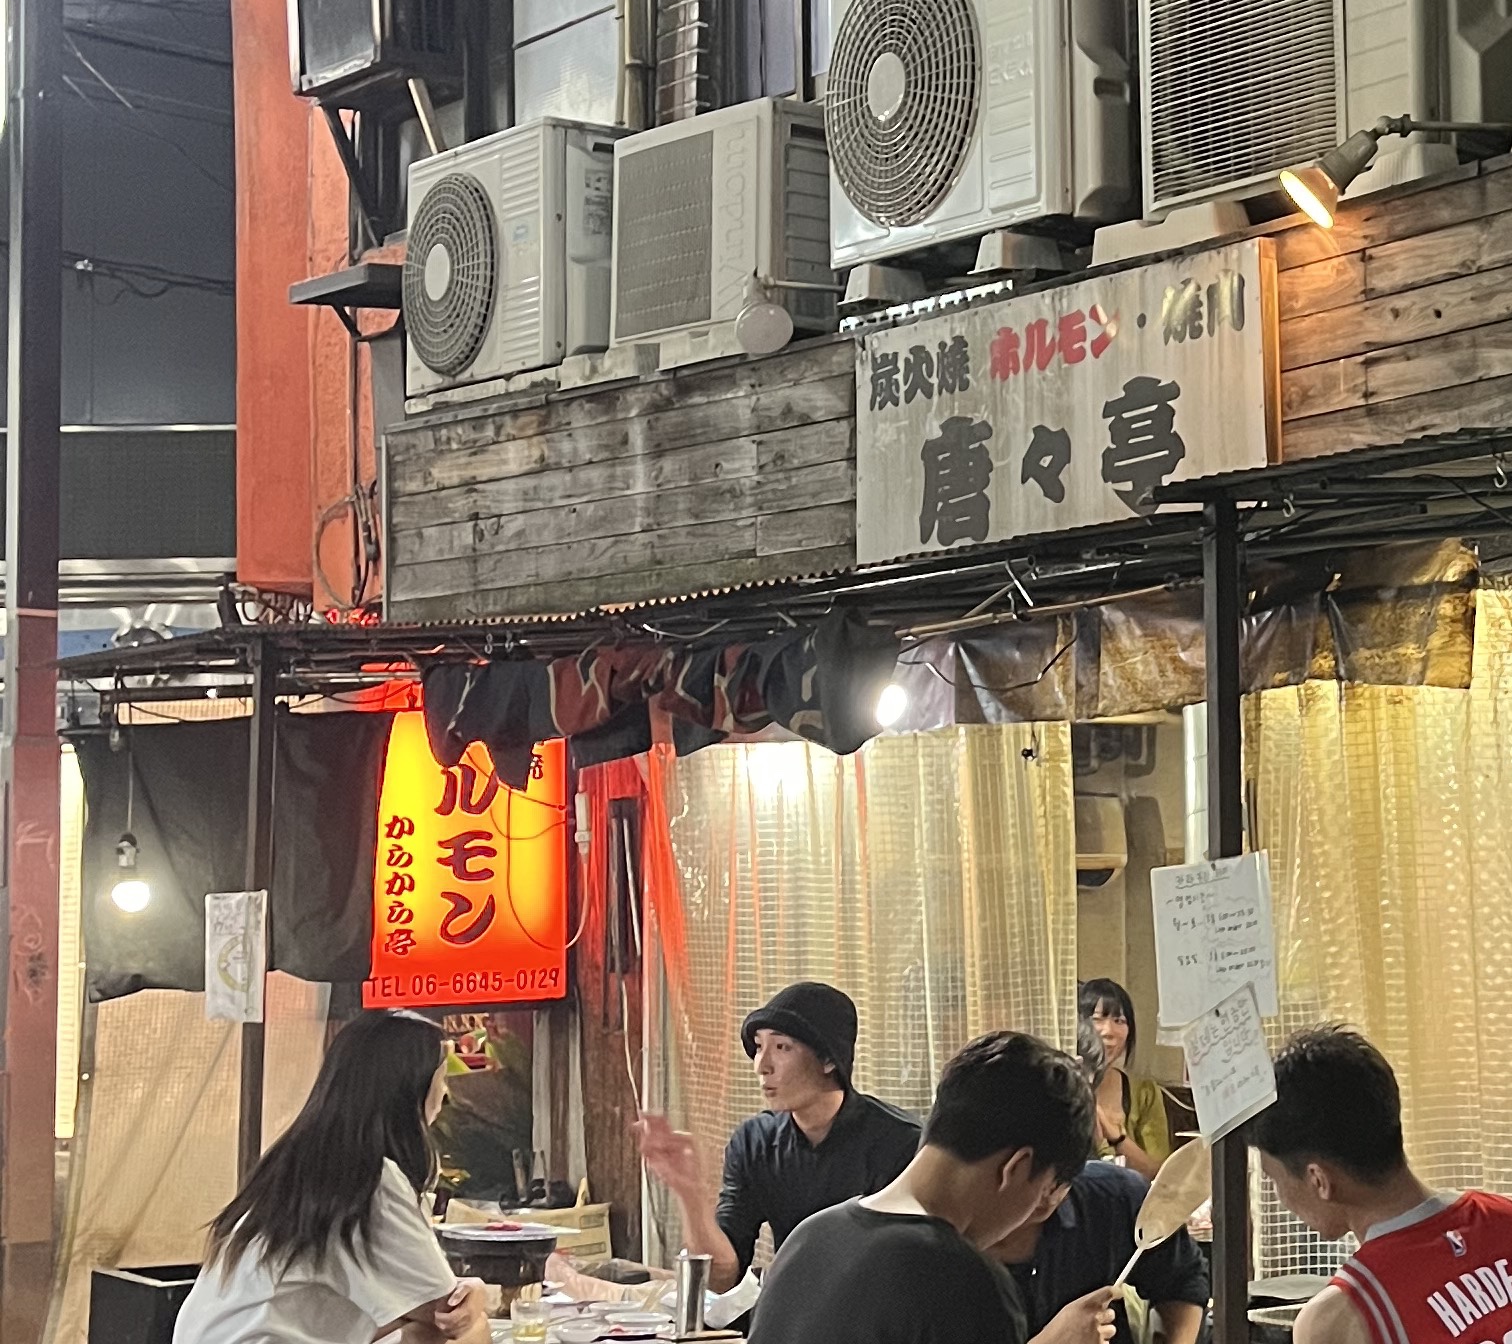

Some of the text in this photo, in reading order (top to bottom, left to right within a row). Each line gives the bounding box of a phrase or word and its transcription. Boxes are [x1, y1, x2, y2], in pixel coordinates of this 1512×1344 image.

[870, 335, 970, 412] 炭火焼
[918, 375, 1186, 546] 唐々亭
[384, 814, 416, 956] からから亭
[433, 762, 498, 946] ルモン
[368, 966, 561, 998] TEL 06-6645-0129
